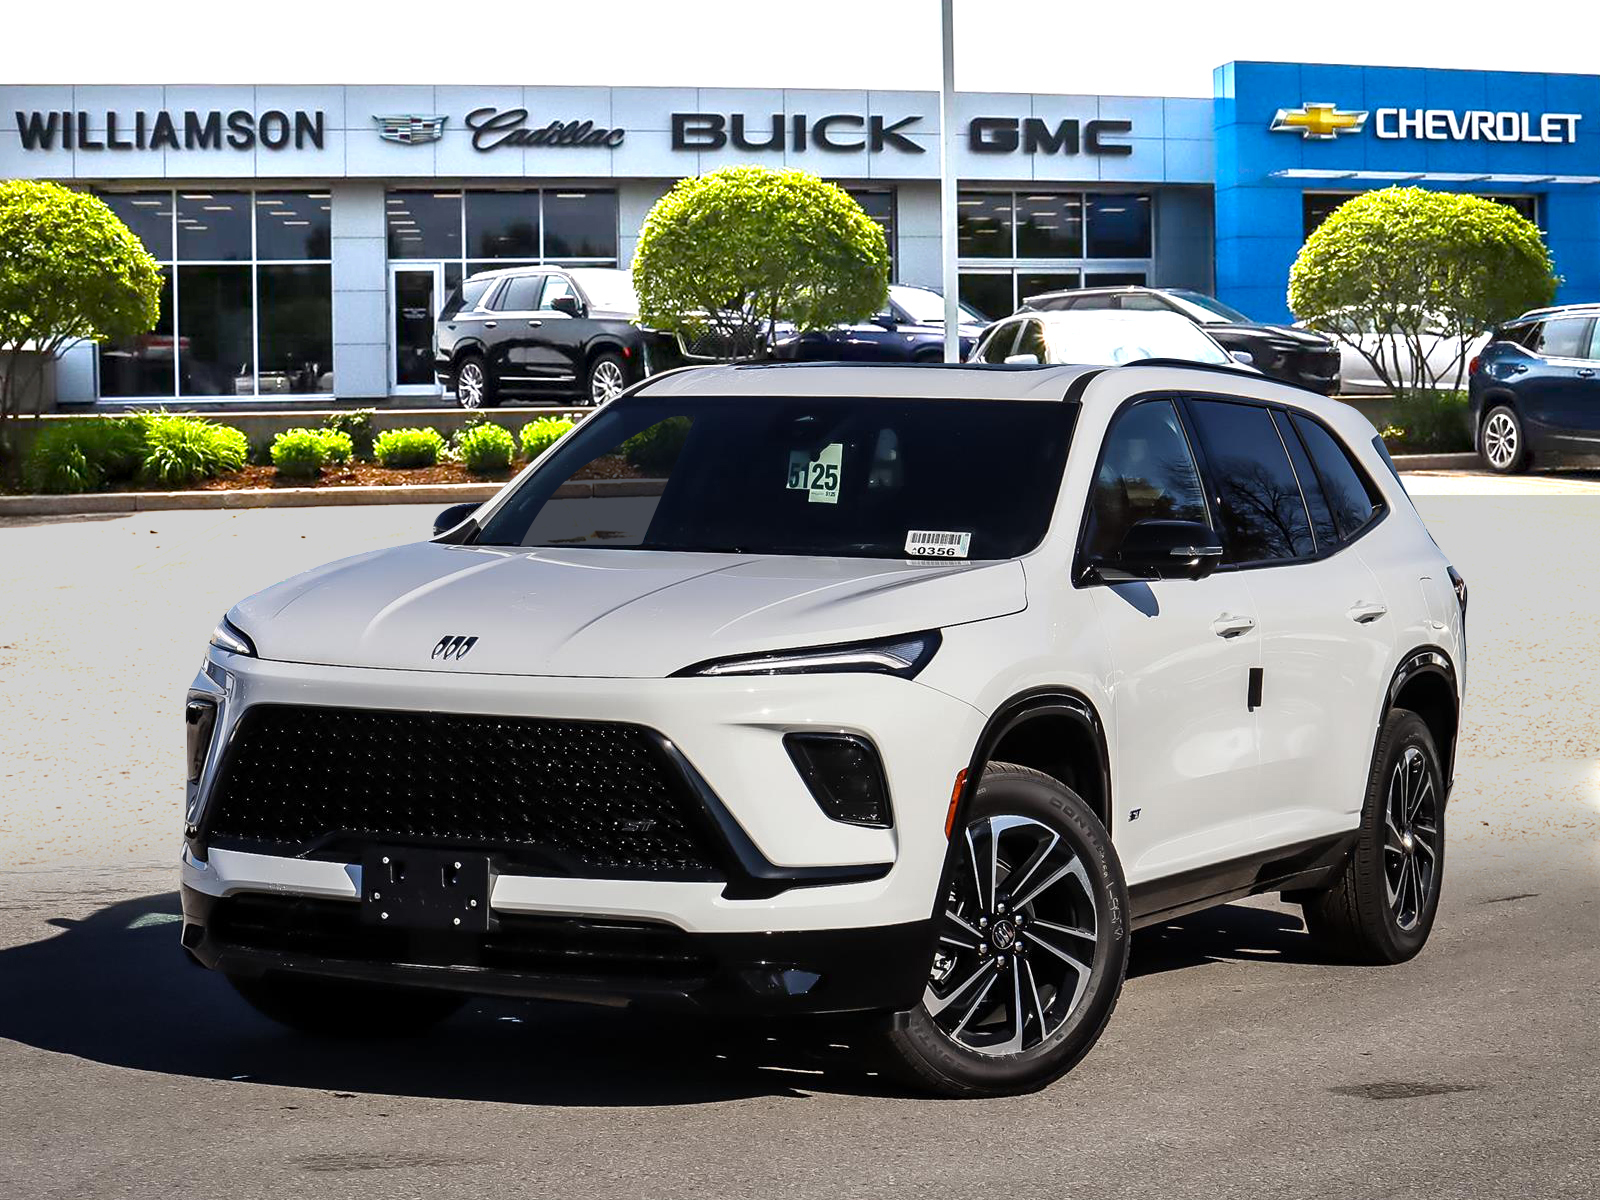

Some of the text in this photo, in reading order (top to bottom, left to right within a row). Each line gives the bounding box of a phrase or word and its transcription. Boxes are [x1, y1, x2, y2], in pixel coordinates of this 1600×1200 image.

[15, 111, 325, 151] WILLIAMSON
[465, 107, 625, 152] Cadillac
[671, 113, 926, 153] BUICK
[969, 116, 1133, 156] GMC
[1375, 107, 1582, 144] CHEVROLET
[917, 546, 956, 557] 0356
